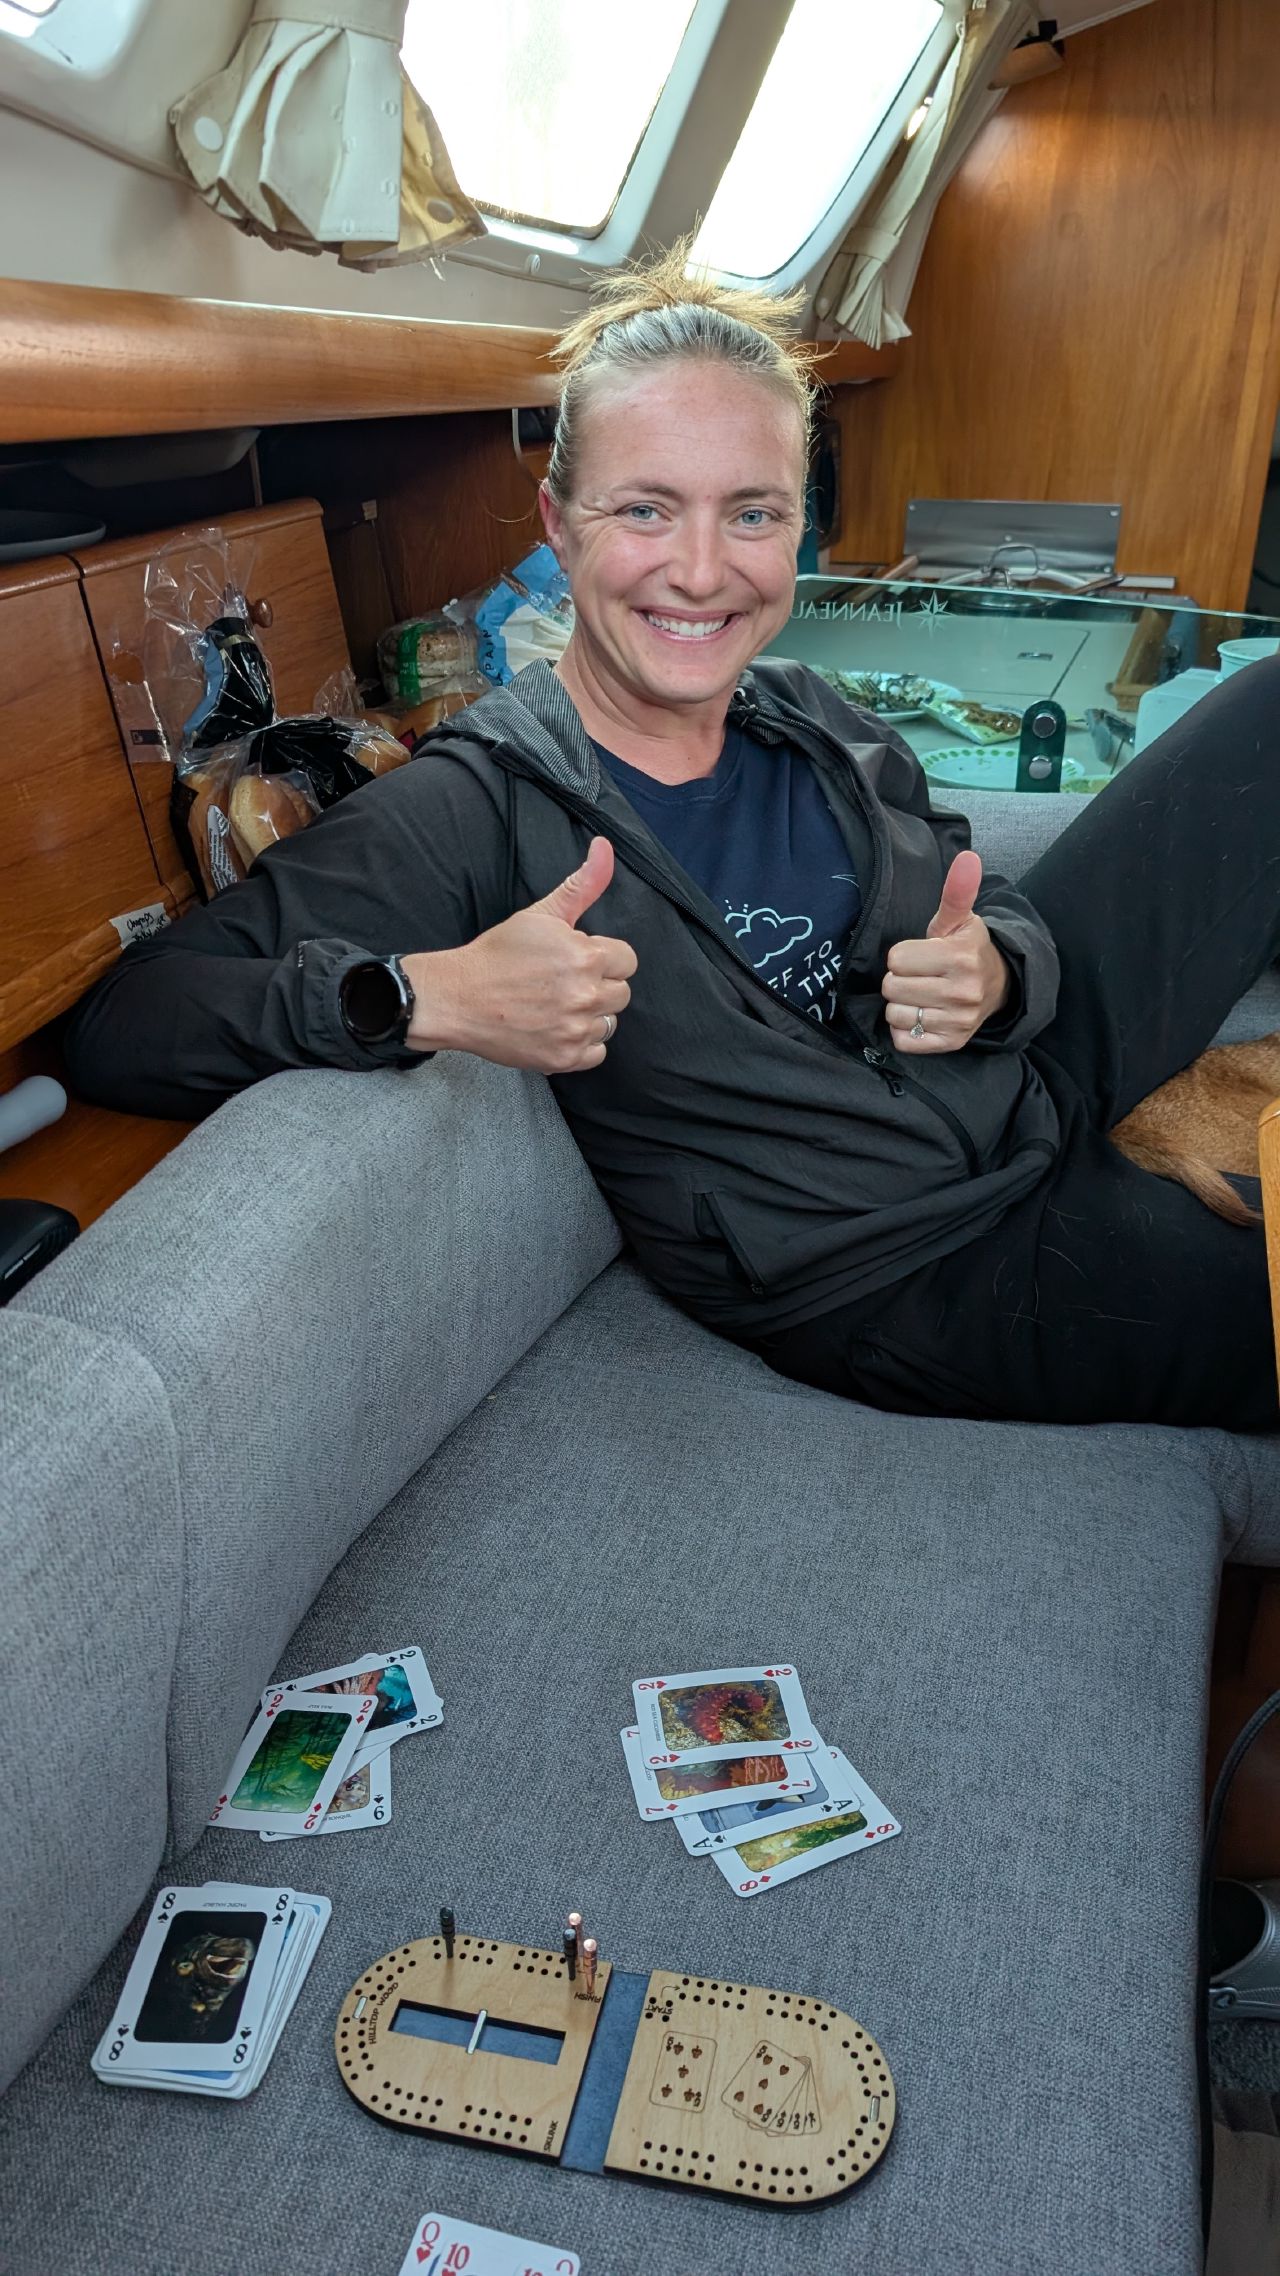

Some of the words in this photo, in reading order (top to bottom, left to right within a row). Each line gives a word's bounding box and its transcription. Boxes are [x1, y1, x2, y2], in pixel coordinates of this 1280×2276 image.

[804, 940, 833, 969] TO
[270, 1693, 284, 1708] 2
[360, 1699, 373, 1713] 2
[162, 1892, 177, 1910] 8
[275, 1893, 290, 1911] 8
[645, 2004, 673, 2015] START
[368, 2007, 380, 2045] HILLTOP
[109, 2040, 125, 2061] 8
[233, 2043, 248, 2064] 8
[543, 2120, 559, 2152] SKUNK
[420, 2220, 441, 2250] Q
[444, 2242, 471, 2270] 10
